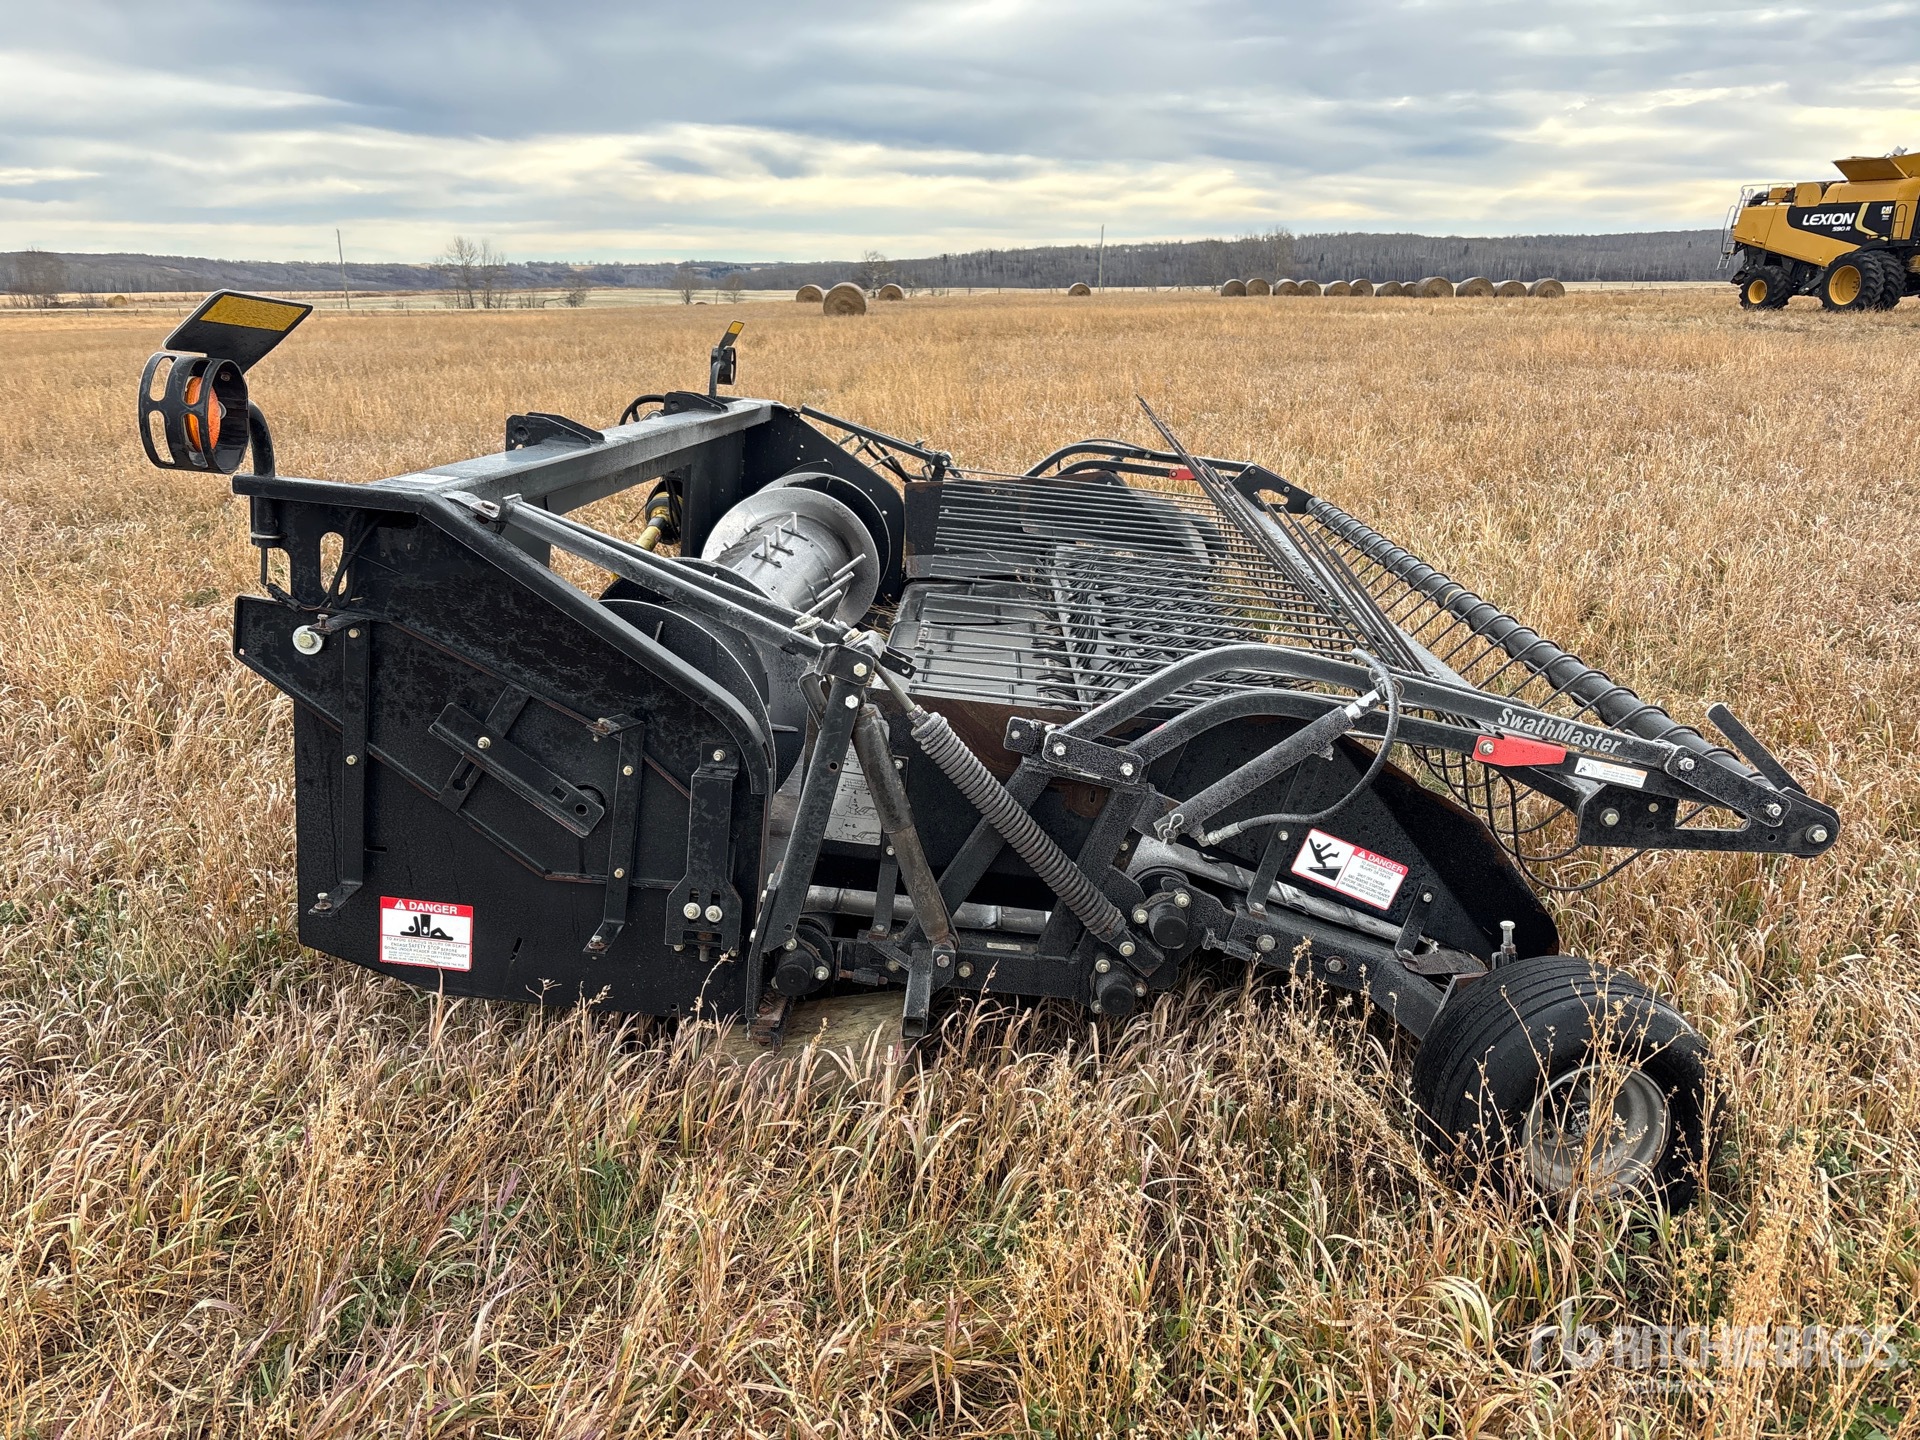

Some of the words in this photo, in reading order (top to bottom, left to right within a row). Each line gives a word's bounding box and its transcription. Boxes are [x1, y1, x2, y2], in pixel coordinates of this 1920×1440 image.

[1881, 206, 1894, 214] CAT
[1802, 213, 1855, 225] LEXION
[1498, 708, 1622, 753] SwathMaster
[1368, 855, 1403, 873] DANGER
[409, 902, 457, 914] DANGER
